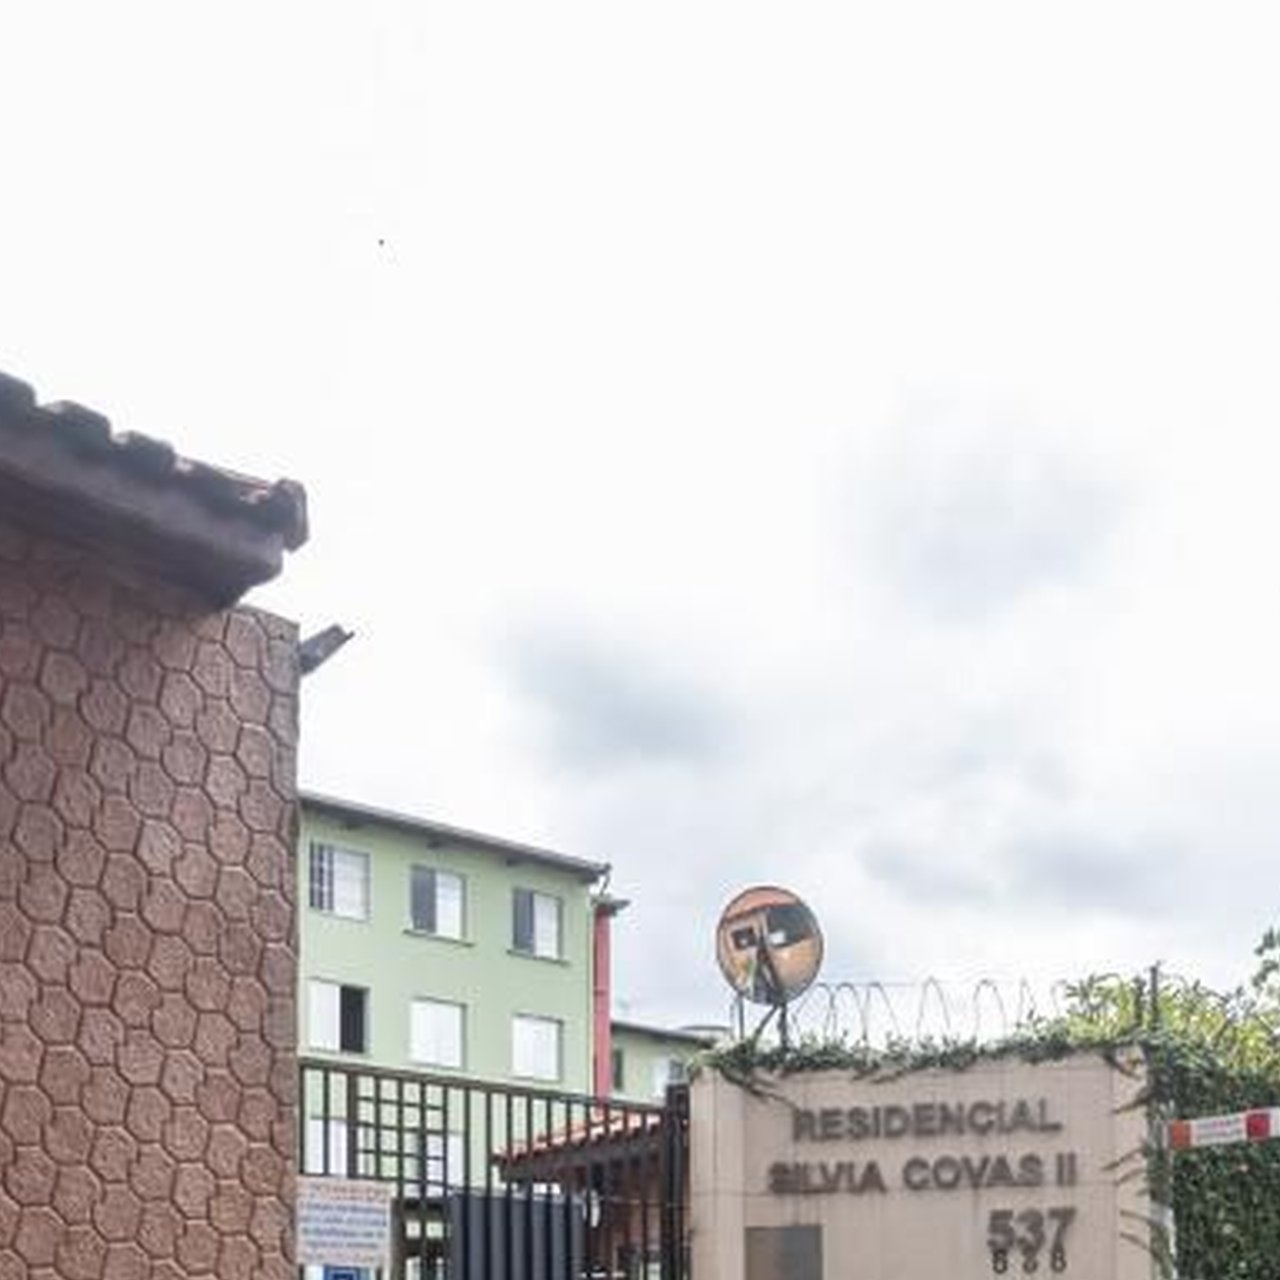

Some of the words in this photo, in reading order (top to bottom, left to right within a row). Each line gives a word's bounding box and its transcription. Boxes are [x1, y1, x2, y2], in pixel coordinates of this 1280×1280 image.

[792, 1099, 1063, 1143] RESIDENCIAL
[768, 1161, 888, 1196] SILVIA
[901, 1154, 1044, 1191] COVAS
[986, 1206, 1077, 1256] 537
